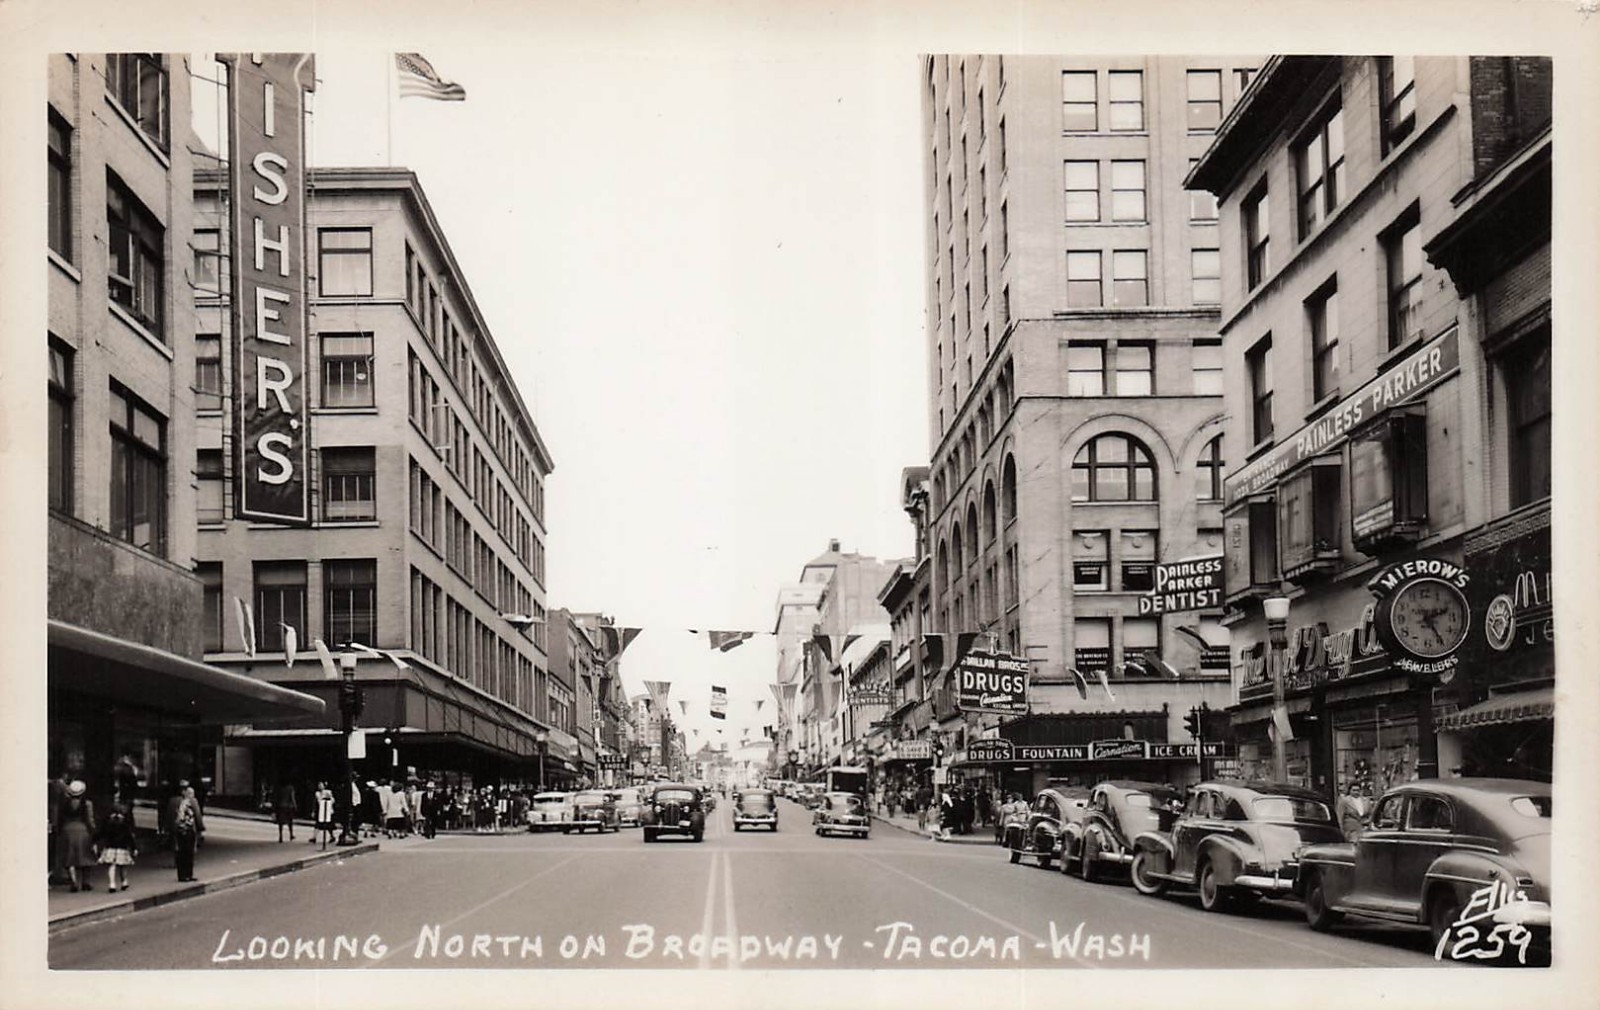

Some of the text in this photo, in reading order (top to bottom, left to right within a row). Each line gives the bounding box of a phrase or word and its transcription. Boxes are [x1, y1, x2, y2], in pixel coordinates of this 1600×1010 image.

[252, 53, 298, 485] ISHER'S
[1297, 346, 1442, 459] PAINLESS PARKER
[1381, 560, 1470, 589] MIEROW'S
[1140, 588, 1221, 615] DENTIST
[963, 670, 1024, 693] DRUGS
[970, 749, 1011, 760] DRUGS
[1022, 748, 1083, 759] FOUNTAIN
[1155, 745, 1173, 756] ICE
